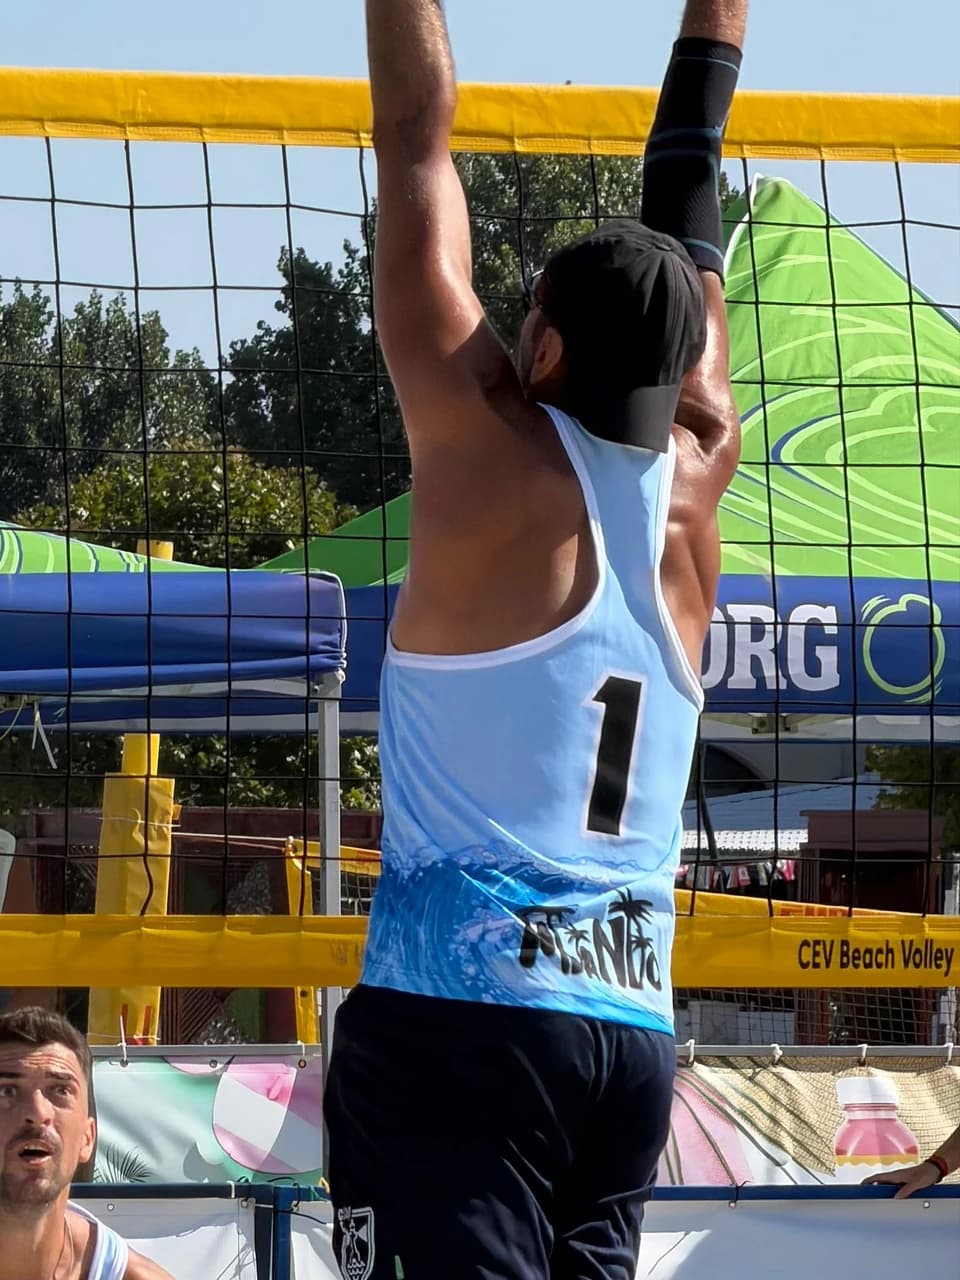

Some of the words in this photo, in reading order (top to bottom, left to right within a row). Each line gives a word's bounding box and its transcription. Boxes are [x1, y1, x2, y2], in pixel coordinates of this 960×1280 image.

[587, 676, 642, 836] 1
[798, 940, 834, 969] CEV
[840, 939, 895, 969] Beach
[901, 939, 955, 976] Volley
